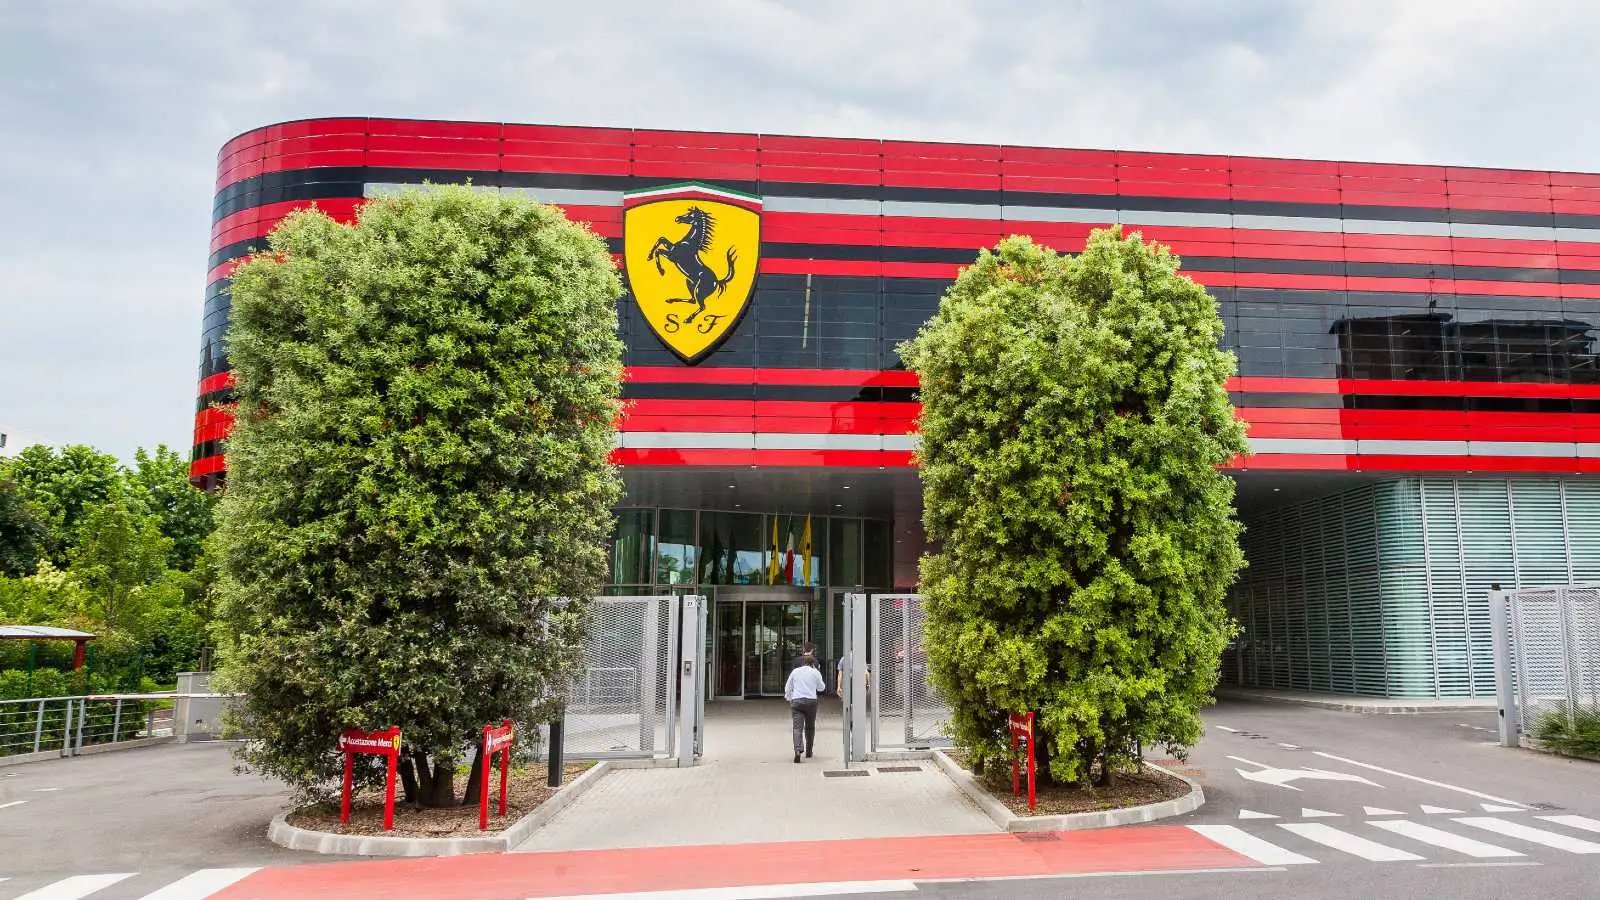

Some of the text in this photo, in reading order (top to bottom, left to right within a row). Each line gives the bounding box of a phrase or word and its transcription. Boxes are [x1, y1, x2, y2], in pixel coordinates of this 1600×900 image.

[664, 313, 728, 334] S F
[377, 737, 392, 748] Merci
